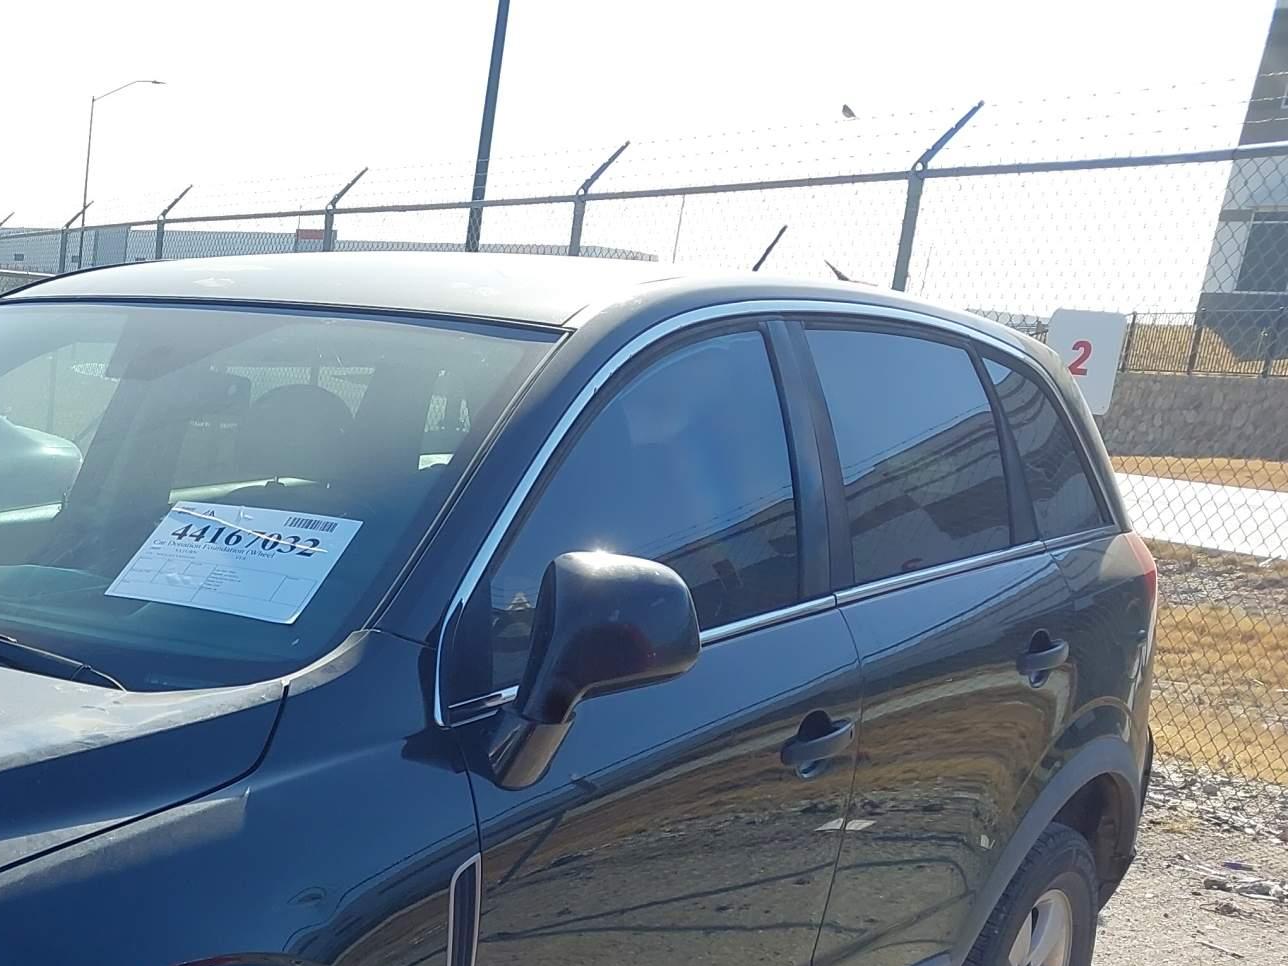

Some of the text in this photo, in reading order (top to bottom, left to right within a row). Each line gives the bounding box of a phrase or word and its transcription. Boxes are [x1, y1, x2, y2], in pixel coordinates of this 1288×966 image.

[1067, 340, 1092, 376] 2
[168, 540, 202, 549] Donation
[202, 544, 244, 554] Foundation
[171, 523, 321, 558] 44167032
